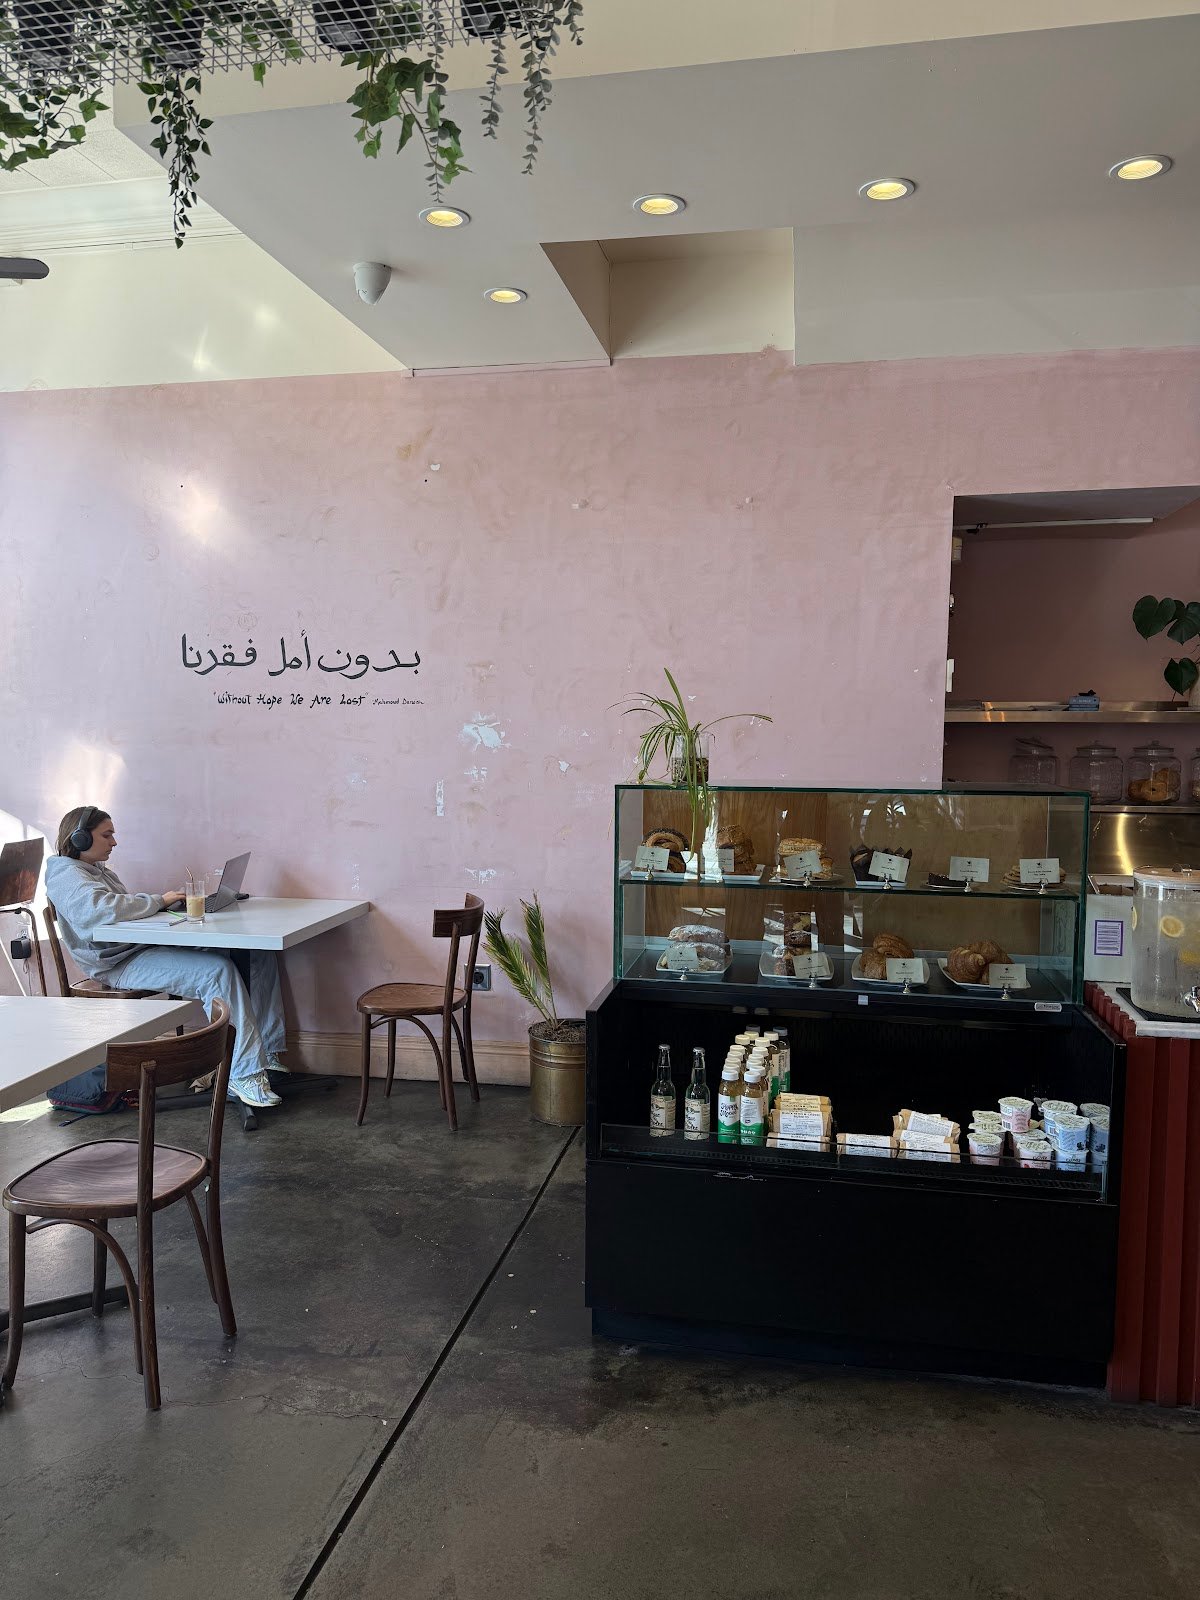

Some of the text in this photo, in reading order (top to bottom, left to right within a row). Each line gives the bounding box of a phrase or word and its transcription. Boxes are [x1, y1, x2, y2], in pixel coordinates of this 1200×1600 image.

[268, 628, 311, 677] أمل
[318, 649, 420, 680] بدون
[256, 693, 282, 710] Hope
[290, 693, 304, 705] We
[310, 694, 331, 708] Are
